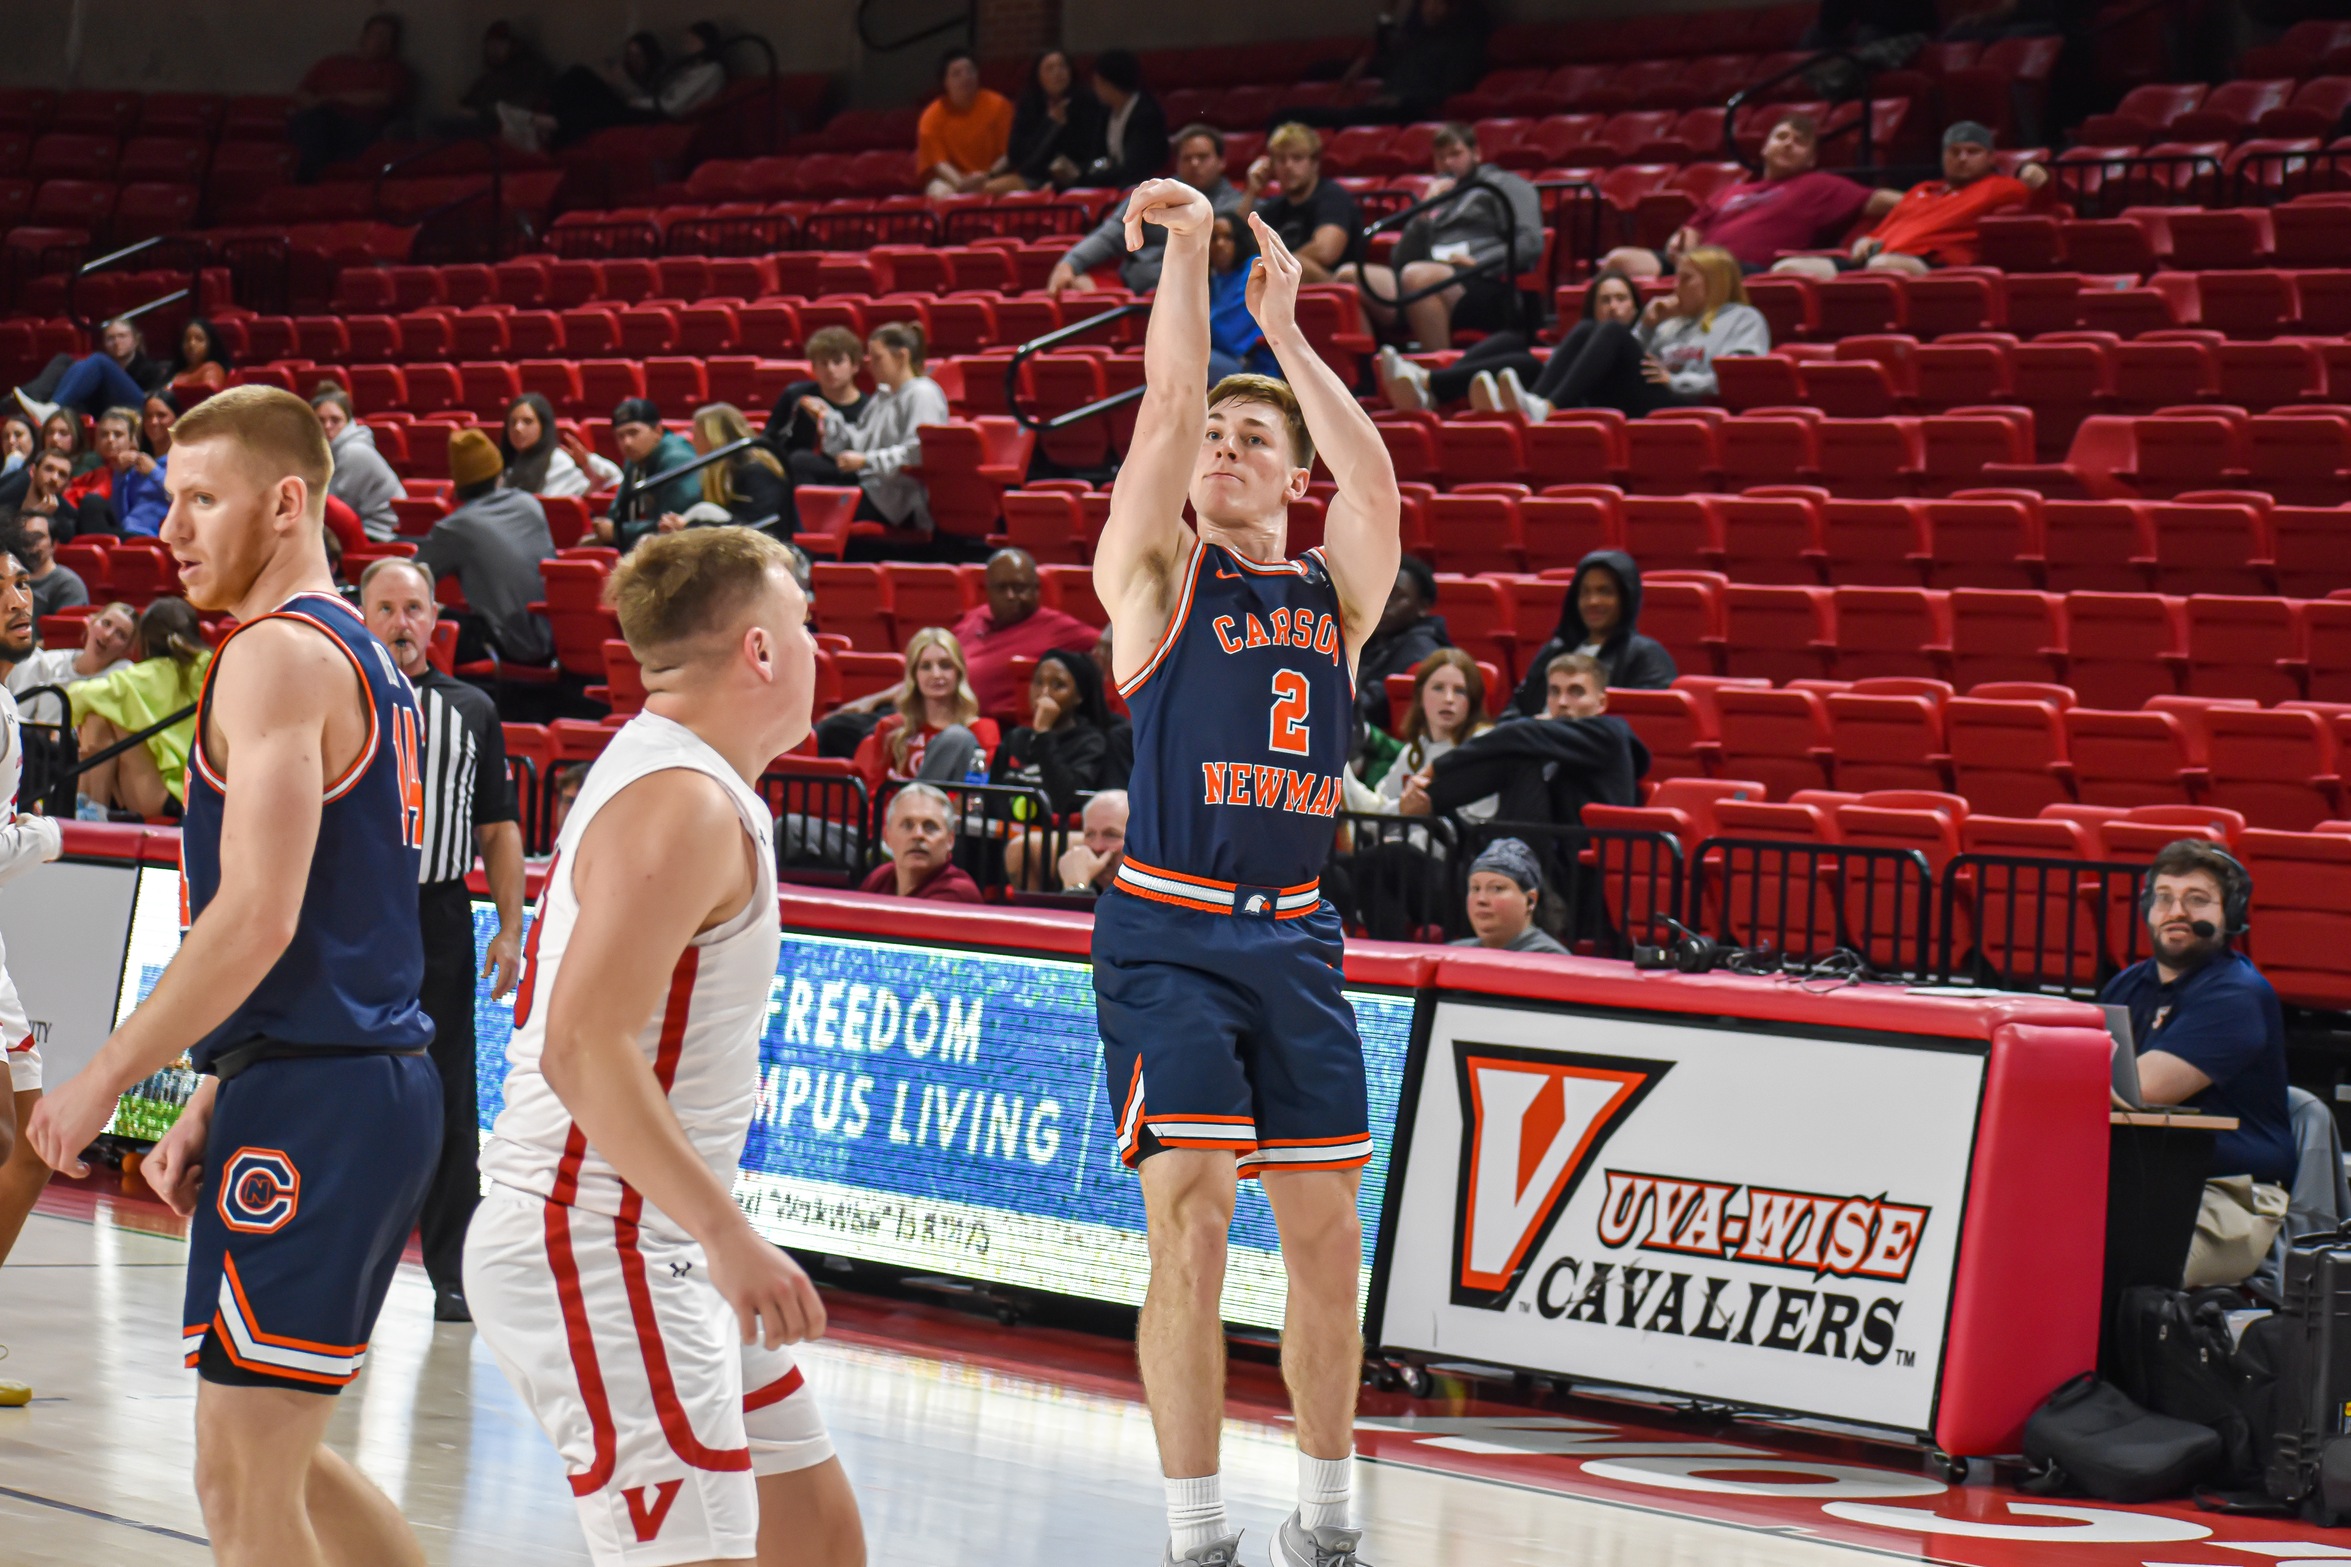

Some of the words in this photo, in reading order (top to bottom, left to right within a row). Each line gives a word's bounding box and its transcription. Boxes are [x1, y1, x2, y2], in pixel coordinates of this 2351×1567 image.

[1268, 667, 1310, 757] 2
[759, 973, 984, 1065] FREEDOM
[754, 1061, 875, 1138] MPUS
[888, 1079, 1062, 1167] LIVING
[1598, 1168, 1932, 1284] UVA-WISE
[1536, 1256, 1904, 1366] CAVALIERS
[1895, 1348, 1915, 1368] TM
[619, 1478, 685, 1543] V
